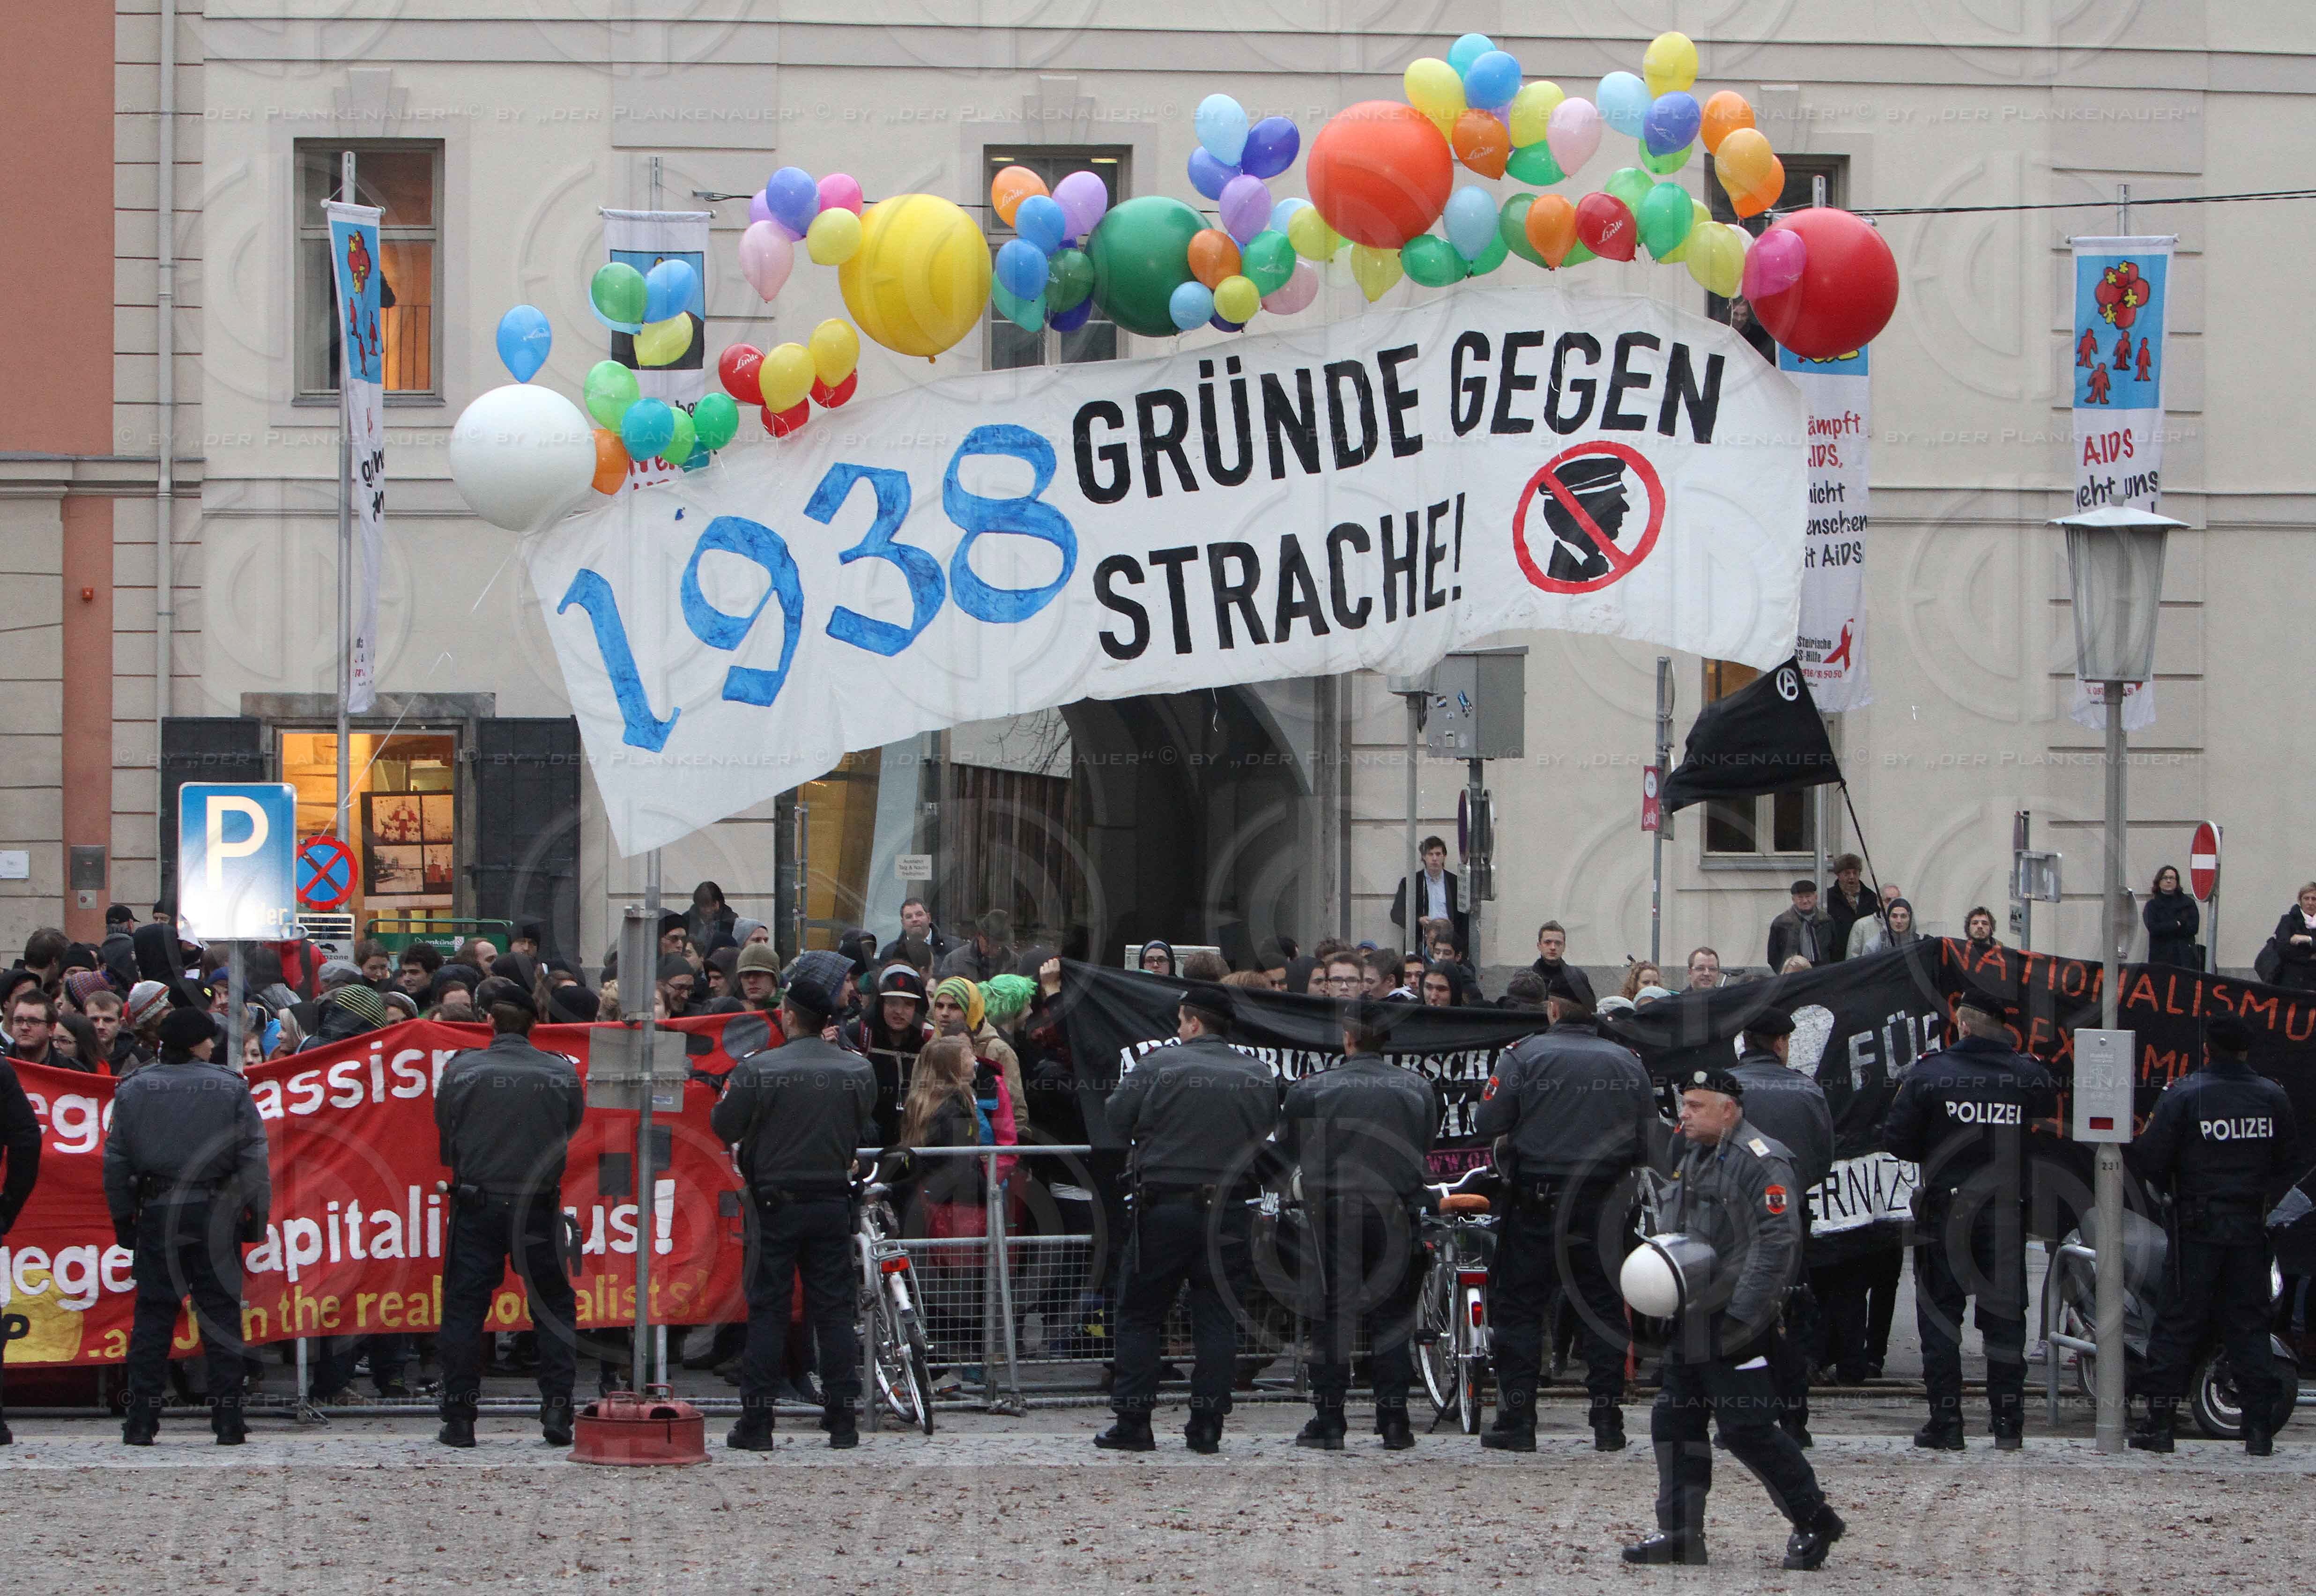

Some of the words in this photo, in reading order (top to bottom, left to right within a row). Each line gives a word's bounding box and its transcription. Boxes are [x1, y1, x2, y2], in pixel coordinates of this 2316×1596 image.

[1596, 220, 1623, 244] Linde
[732, 353, 758, 374] Linde
[1073, 343, 1423, 504] GRÜNDE
[1450, 330, 1725, 444] GEGEN
[2083, 428, 2134, 466] AIDS
[557, 423, 1078, 753] 1938
[1093, 492, 1465, 660] STRACHE!
[206, 796, 268, 891] P
[1945, 1101, 2021, 1125] POLIZEI
[2199, 1116, 2273, 1141] POLIZEI
[2102, 1161, 2120, 1171] 231
[278, 1285, 341, 1333] the
[356, 1274, 442, 1328] real
